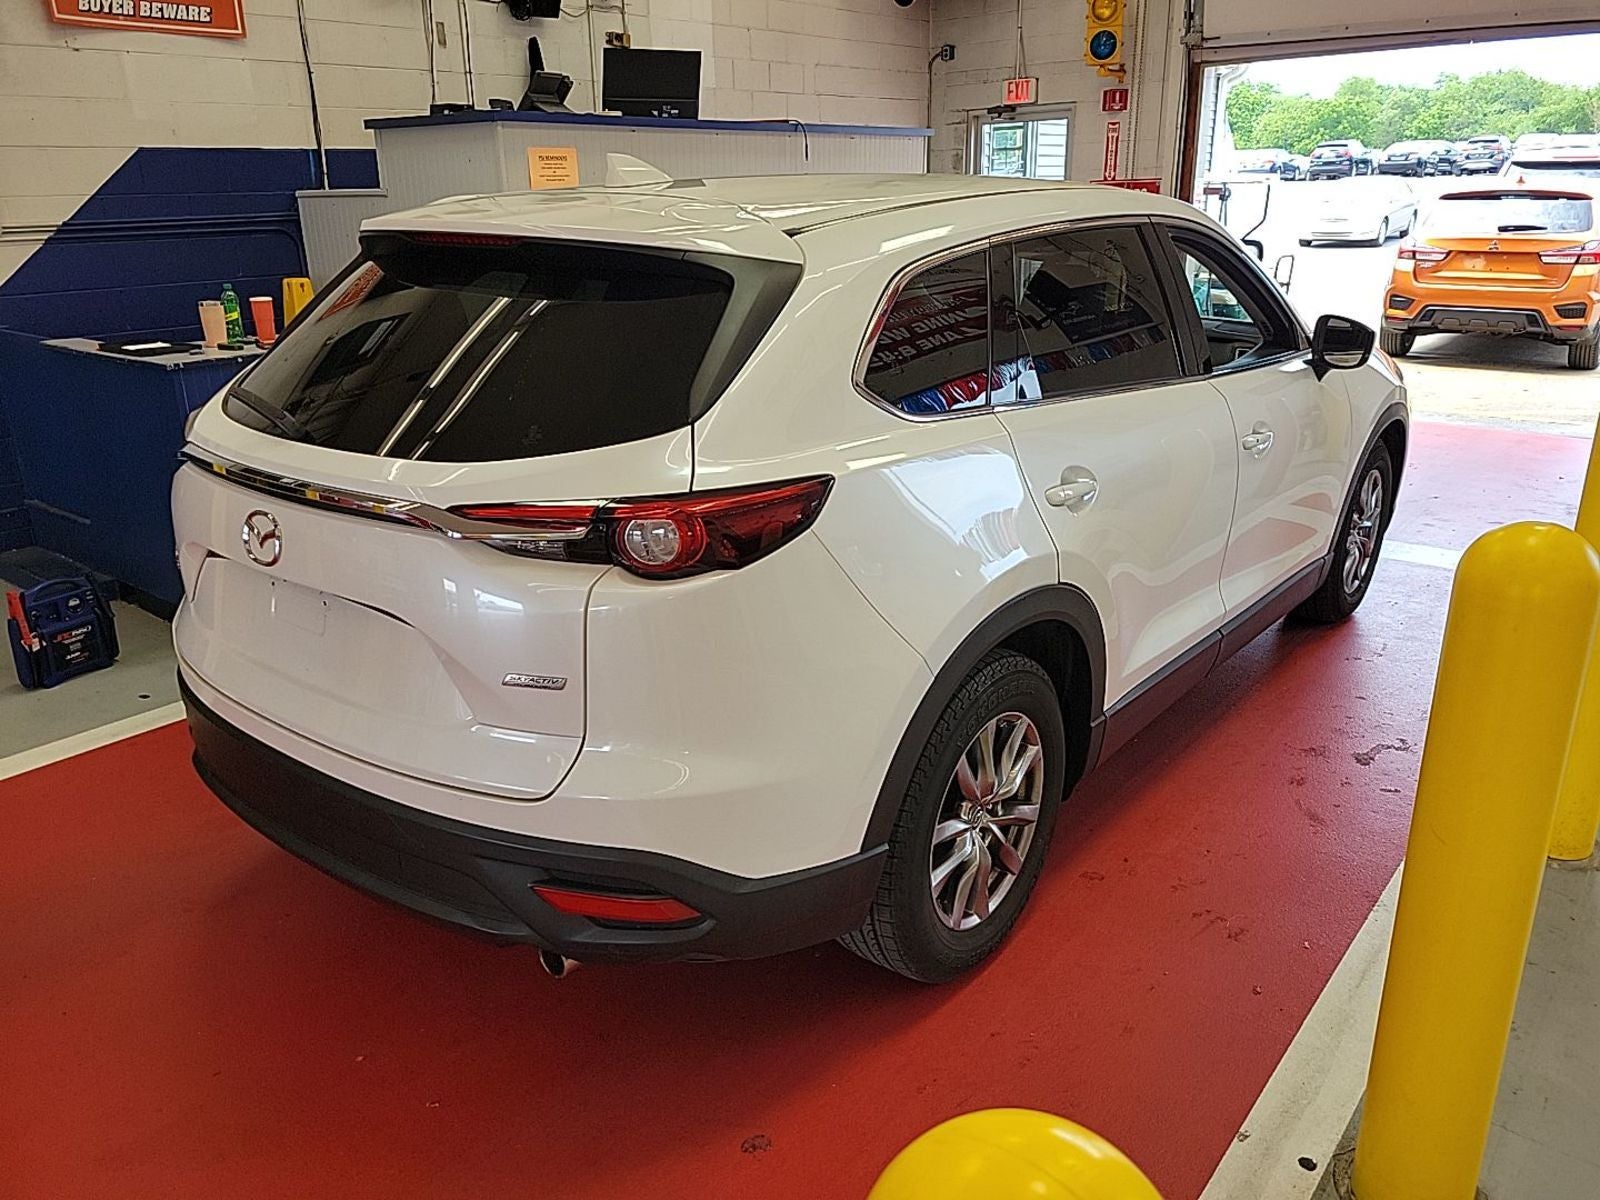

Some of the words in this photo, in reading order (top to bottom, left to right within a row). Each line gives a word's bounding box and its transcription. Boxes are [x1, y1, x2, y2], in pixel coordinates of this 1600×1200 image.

[77, 0, 135, 16] BUYER
[139, 1, 212, 22] BEWARE
[1007, 80, 1031, 101] EXIT
[507, 676, 560, 685] SKYACTIV
